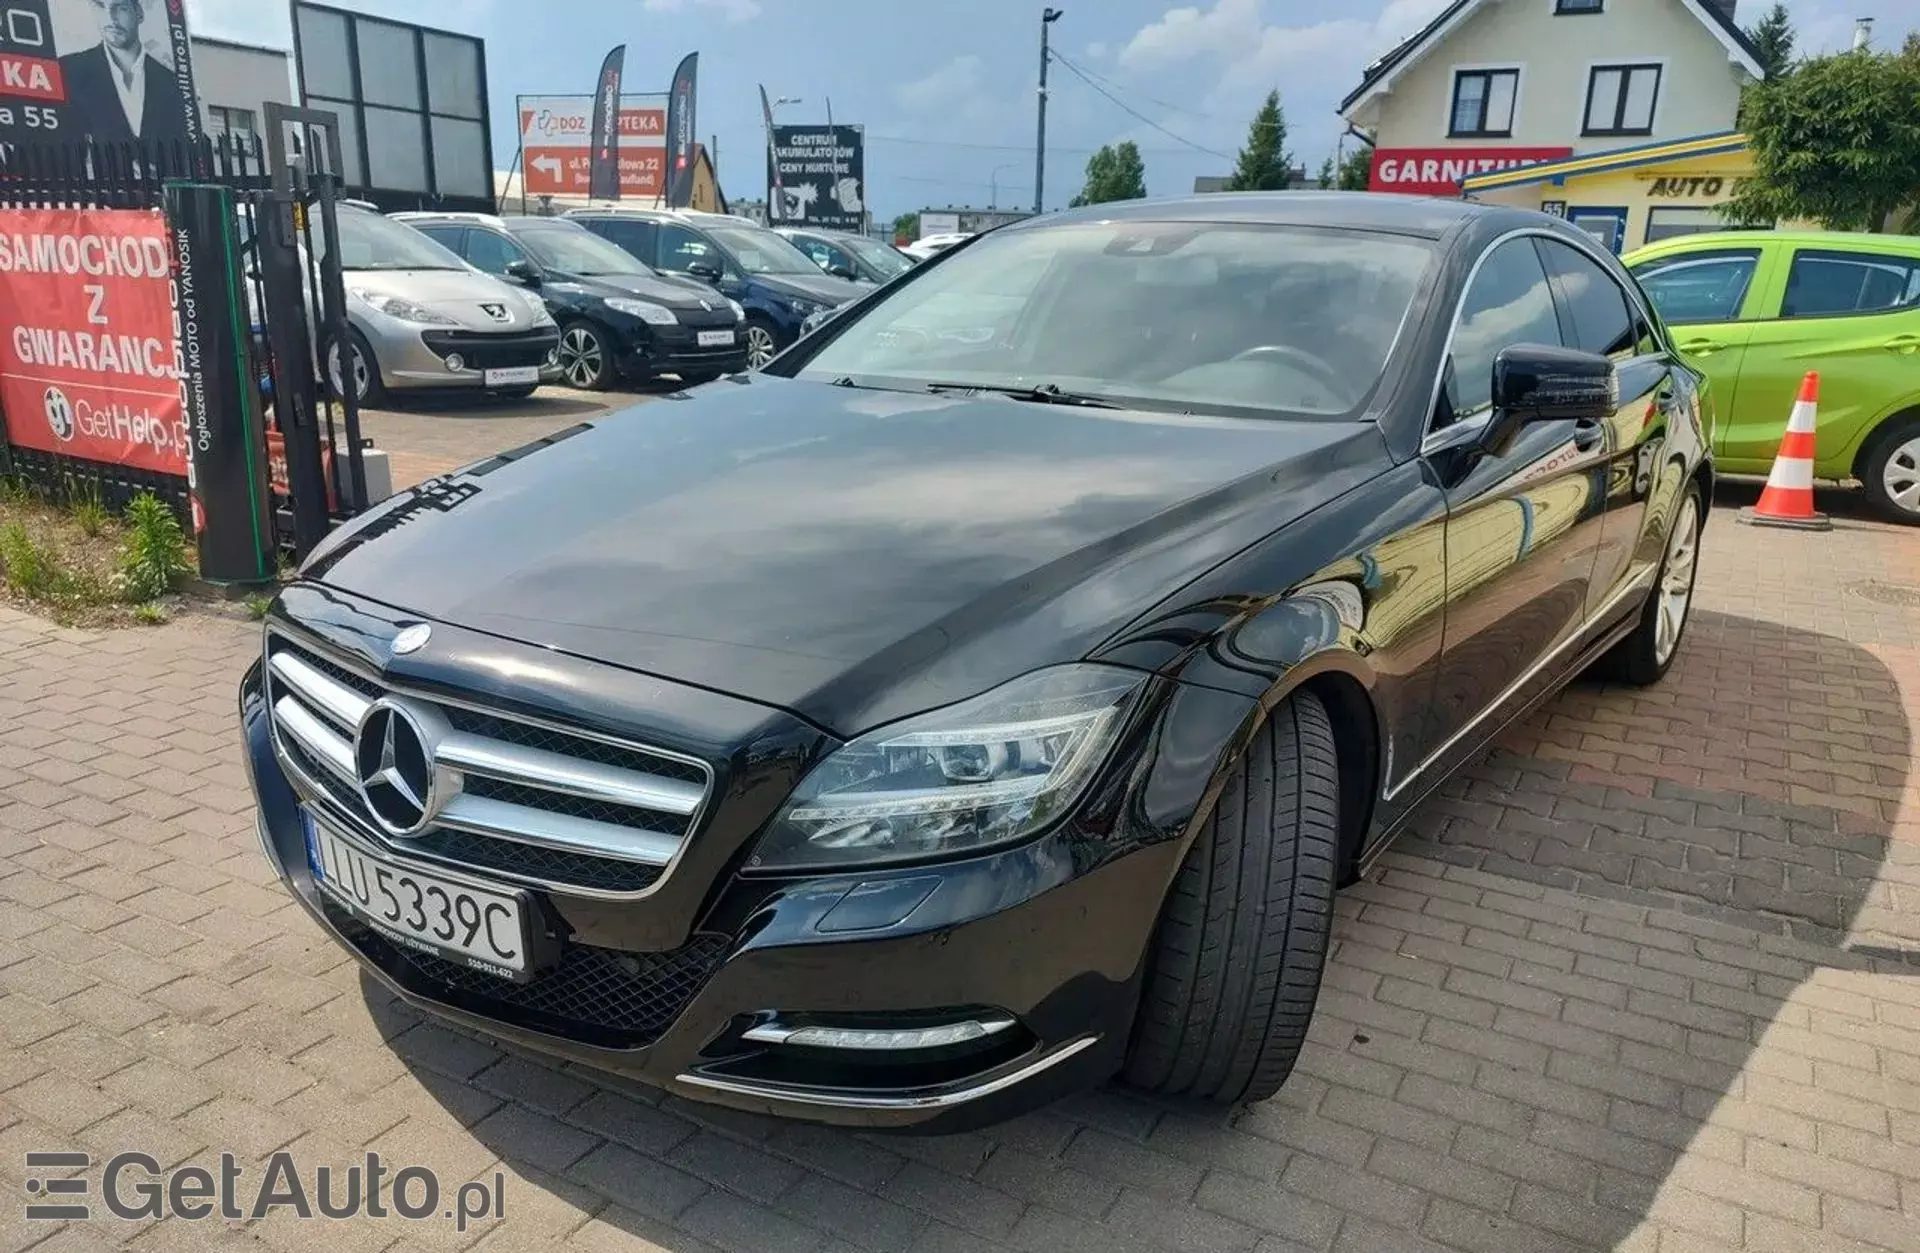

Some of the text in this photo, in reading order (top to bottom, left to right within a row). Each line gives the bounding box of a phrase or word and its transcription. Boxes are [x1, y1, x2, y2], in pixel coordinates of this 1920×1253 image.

[24, 106, 59, 129] 55
[560, 117, 586, 130] DOZ
[646, 157, 659, 170] 22
[1647, 177, 1723, 197] AUTO
[84, 285, 108, 324] Z
[177, 229, 212, 452] Ogłoszenia MOTO od YANOSIK
[375, 867, 516, 960] 5339C
